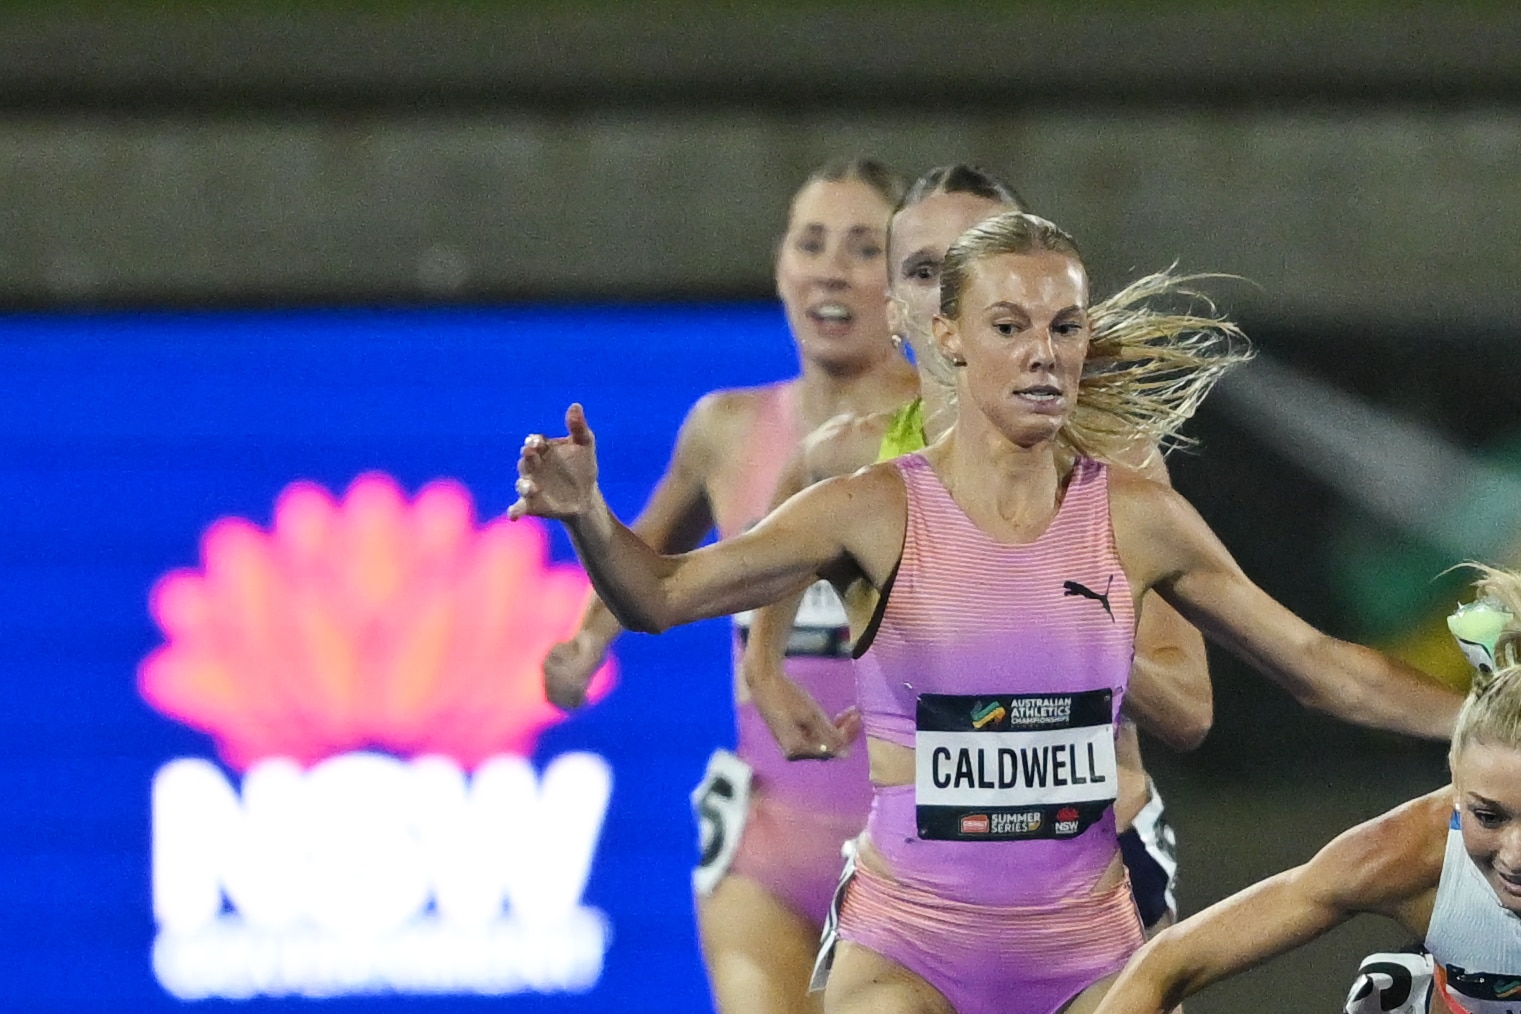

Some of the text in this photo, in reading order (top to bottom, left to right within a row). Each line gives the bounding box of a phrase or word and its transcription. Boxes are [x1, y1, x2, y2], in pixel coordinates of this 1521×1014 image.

[1011, 697, 1072, 707] AUSTRALIAN
[1011, 706, 1071, 718] ATHLETICS
[931, 742, 1106, 789] CALDWELL
[991, 812, 1041, 823] SUMMER
[991, 822, 1028, 833] SERIES
[1055, 821, 1078, 832] NSW
